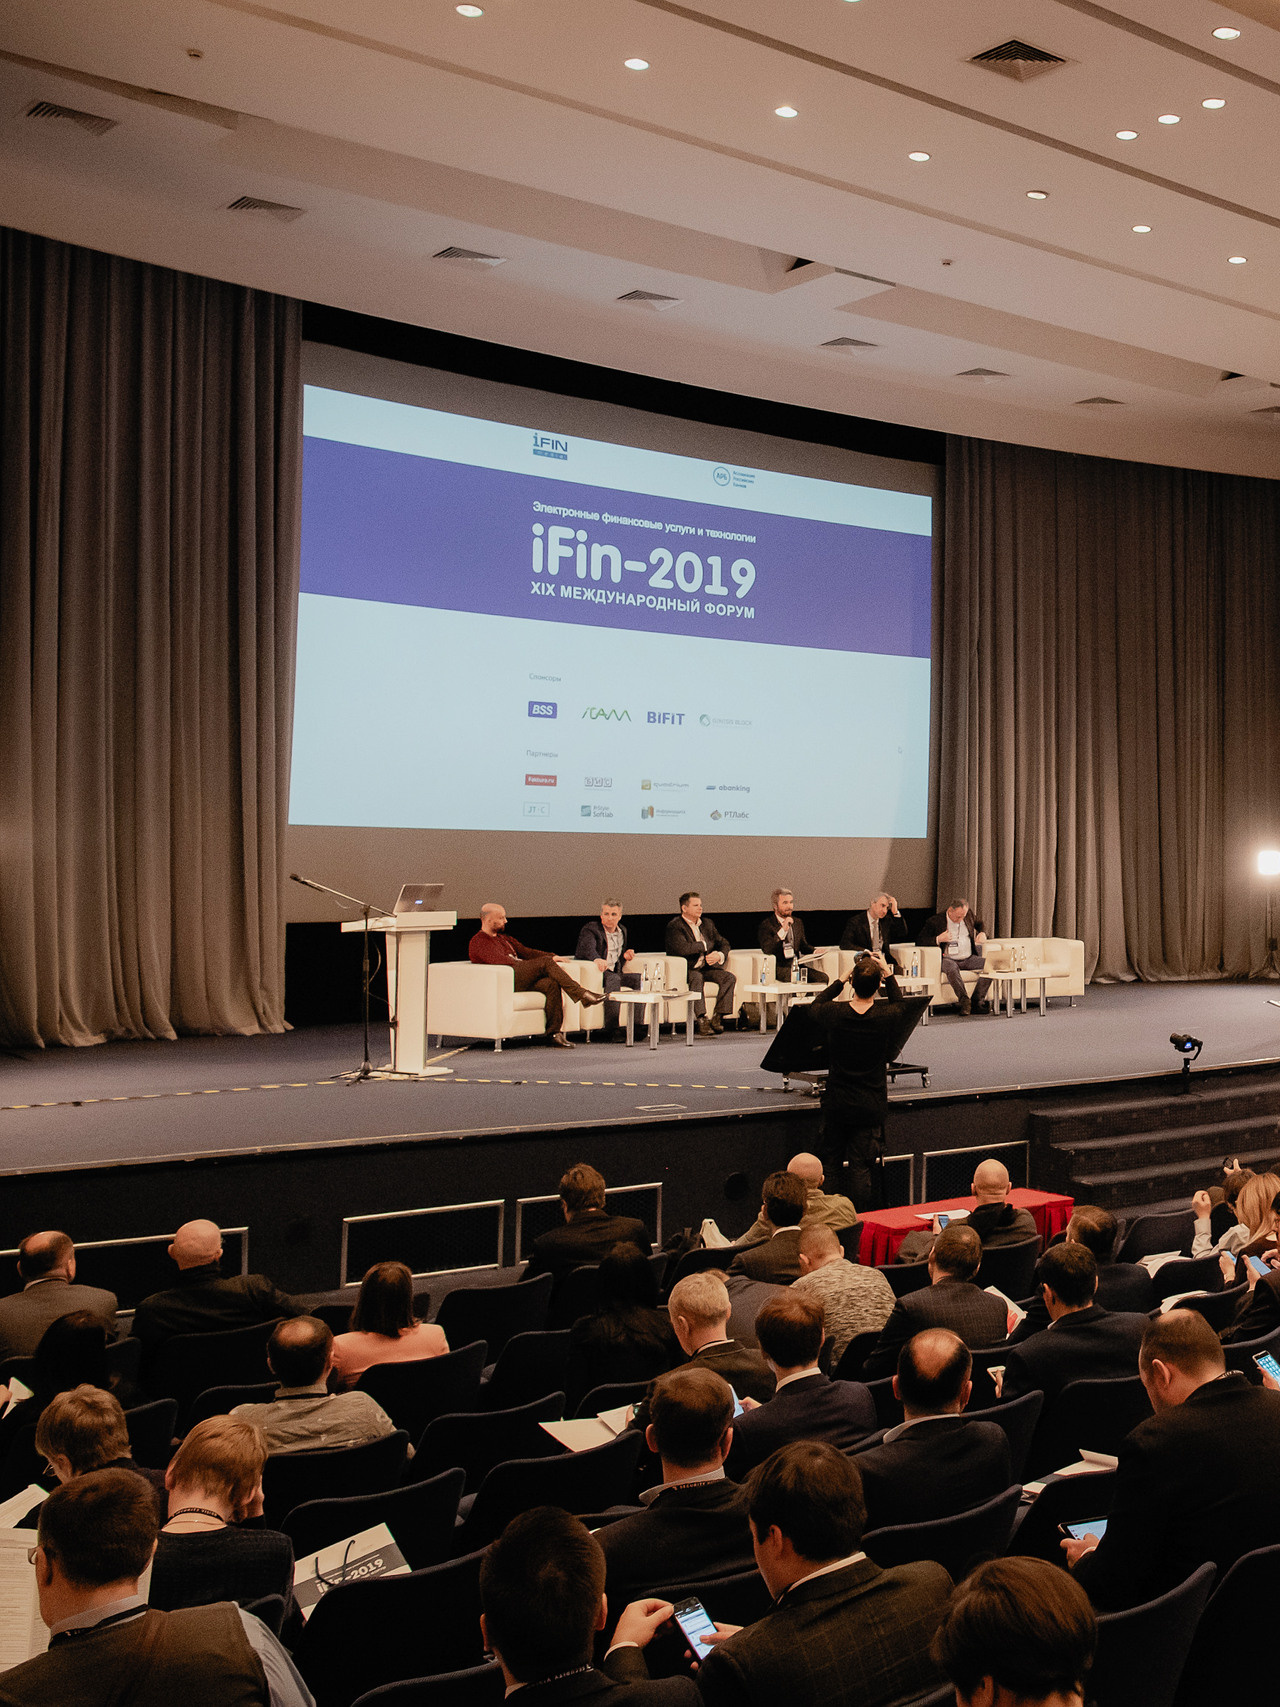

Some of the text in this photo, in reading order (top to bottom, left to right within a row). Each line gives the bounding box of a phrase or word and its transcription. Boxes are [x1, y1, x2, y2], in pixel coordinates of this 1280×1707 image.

[532, 501, 756, 543] Электронные финансовые услуги и технологии
[531, 522, 756, 599] iFin-2019
[530, 581, 755, 619] XIX МЕЖДУНАРОДНЫЙ ФОРУМ
[532, 704, 554, 716] BSS
